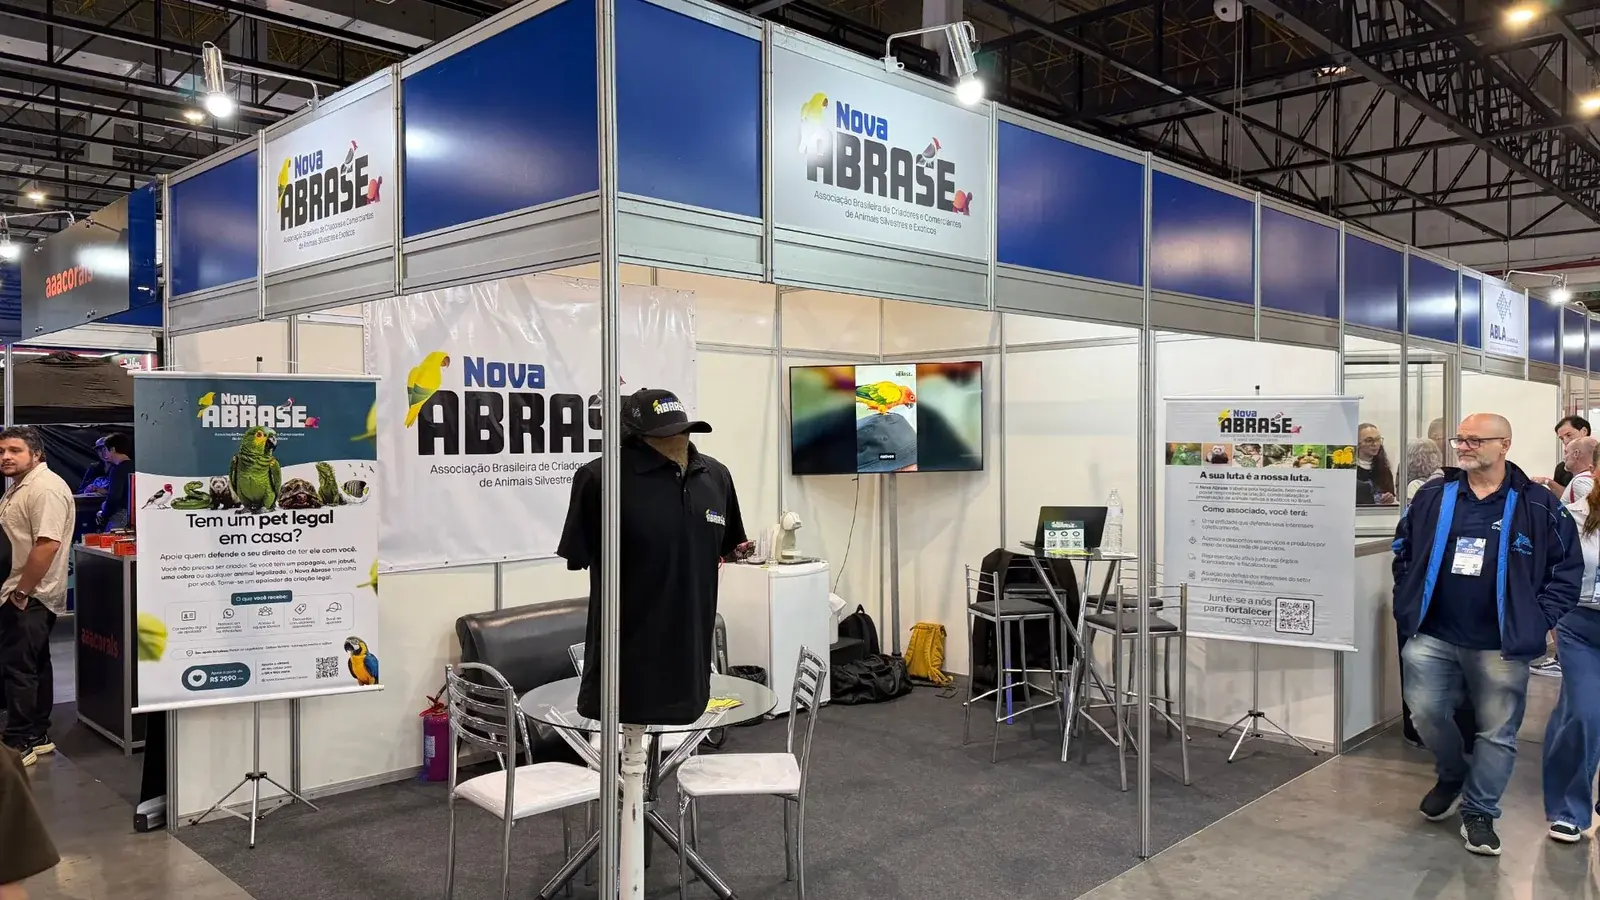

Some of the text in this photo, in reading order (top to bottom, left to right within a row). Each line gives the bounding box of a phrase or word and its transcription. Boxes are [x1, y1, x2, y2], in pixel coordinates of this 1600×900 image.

[836, 101, 888, 141] Nova
[295, 150, 322, 178] Nova
[807, 129, 955, 212] ABRASE
[280, 155, 368, 231] ABRASE
[814, 191, 852, 206] Associação
[853, 199, 881, 212] Brasileira
[892, 207, 919, 219] Criadores
[925, 214, 961, 228] Comerciantes
[845, 210, 853, 218] de
[855, 212, 879, 223] Animais
[880, 217, 908, 229] Silvestres
[1490, 324, 1506, 341] ABLA
[463, 356, 545, 389] Nova
[221, 393, 256, 405] Nova
[202, 405, 307, 428] ABRASE
[1221, 418, 1292, 433] ABRASE
[430, 463, 491, 477] Associação
[493, 462, 536, 473] Brasileira
[539, 462, 550, 471] de
[1200, 471, 1207, 479] A
[1227, 472, 1244, 480] luta
[1290, 474, 1312, 482] luta.
[479, 478, 493, 487] de
[495, 476, 533, 487] Animais
[1202, 505, 1224, 513] Como
[1226, 506, 1267, 515] associado,
[186, 510, 333, 529] Tem um pet legal
[219, 528, 302, 544] em casa?
[160, 553, 182, 561] Apoie
[206, 572, 232, 580] qualquer
[1208, 594, 1246, 604] Junte-se
[1255, 597, 1272, 606] nós
[1203, 604, 1271, 616] para fortalecer
[1253, 619, 1271, 627] voz!
